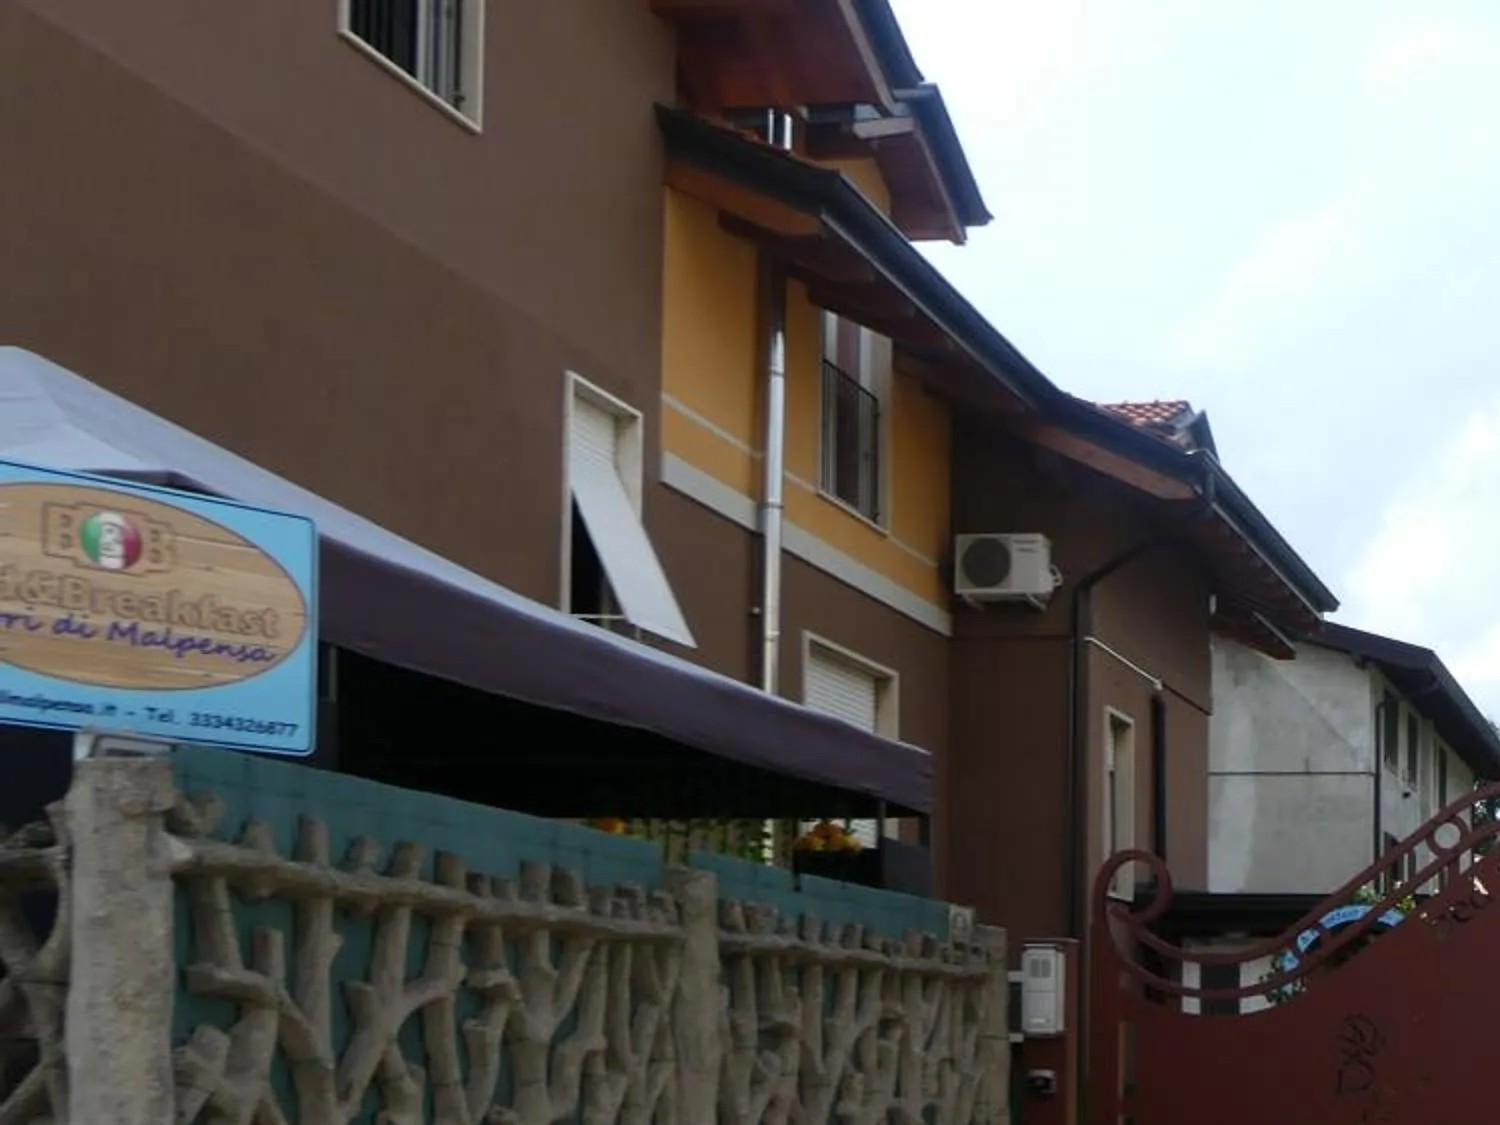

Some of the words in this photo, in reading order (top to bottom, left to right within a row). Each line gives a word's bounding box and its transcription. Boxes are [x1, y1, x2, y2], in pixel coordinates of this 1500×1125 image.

[58, 574, 281, 639] Breakfast
[52, 611, 97, 639] di
[106, 620, 278, 663] Malpensa
[144, 706, 181, 725] Tel.
